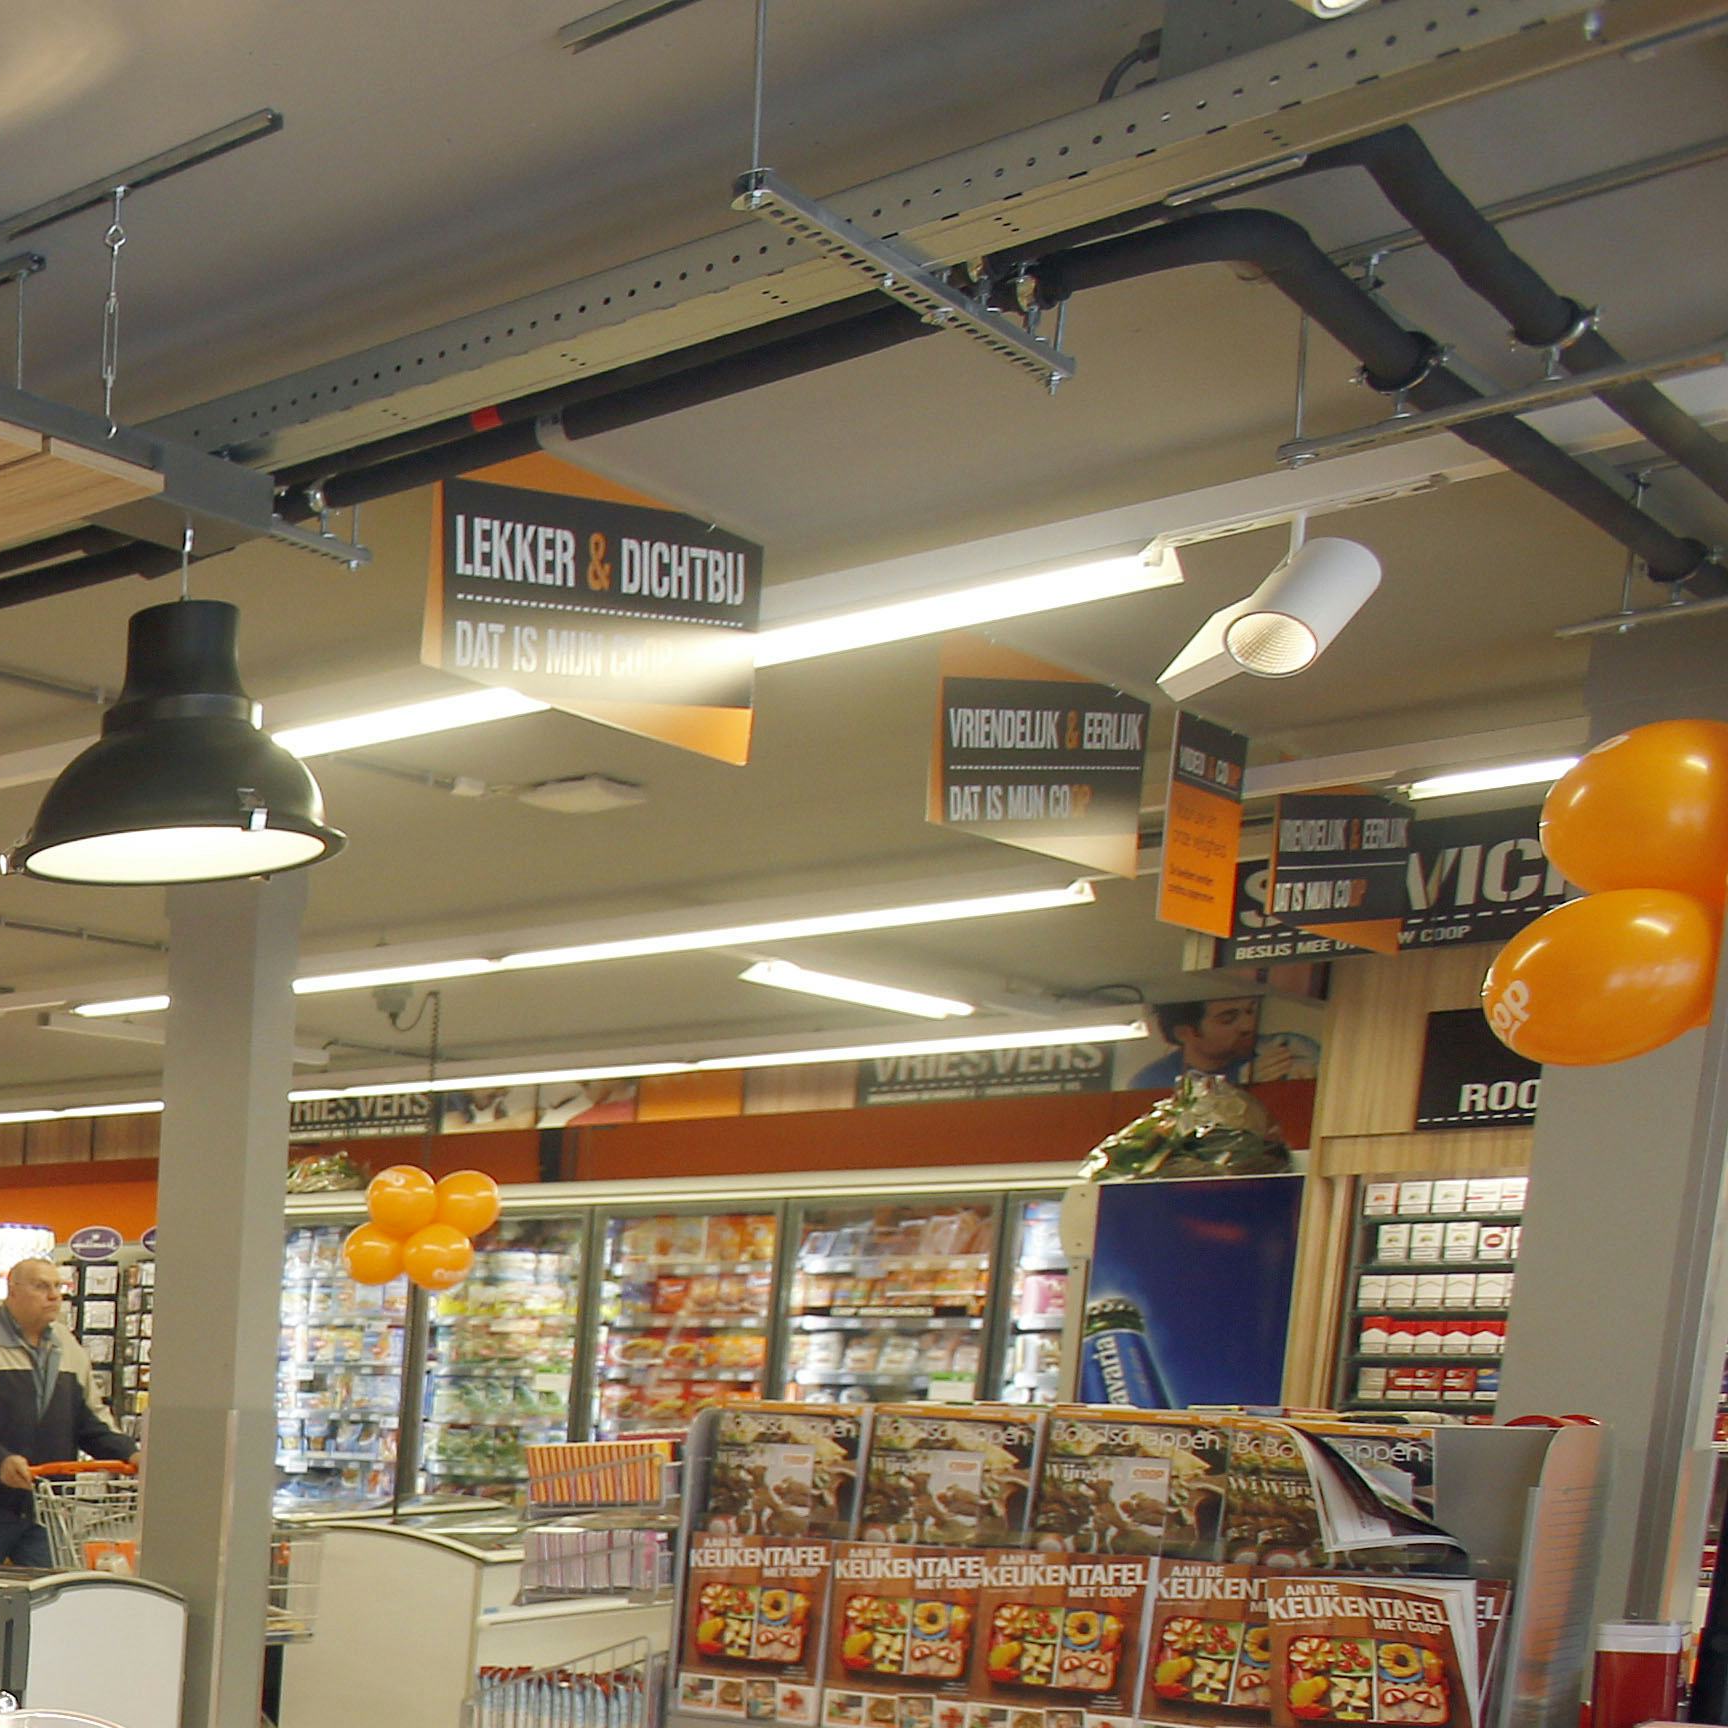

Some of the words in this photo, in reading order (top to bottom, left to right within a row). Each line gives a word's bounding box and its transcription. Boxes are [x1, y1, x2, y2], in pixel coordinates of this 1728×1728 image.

[455, 514, 576, 589] LEKKER
[587, 532, 612, 591] &
[621, 537, 745, 606] DICHTBIJ
[455, 619, 505, 669] DAT
[512, 625, 538, 673] IS
[546, 628, 603, 676] MIJN
[949, 707, 1061, 750] VRIENDELIJK
[1065, 710, 1080, 750] &
[1083, 711, 1144, 751] EERLIJK
[950, 784, 982, 822] DAT
[986, 785, 1004, 821] IS
[1008, 784, 1044, 821] MIJN
[1049, 784, 1092, 821] COOP
[1420, 925, 1472, 944] COOP
[1296, 938, 1331, 955] MEE
[292, 1094, 432, 1123] RIESVERS
[1091, 1336, 1129, 1404] avaria
[703, 1537, 728, 1548] AAN
[730, 1537, 744, 1548] DE
[690, 1547, 831, 1569] KEUKENTAFEL
[835, 1557, 984, 1580] KEUKENTAFE
[999, 1554, 1026, 1565] AAN
[1029, 1554, 1045, 1565] DE
[762, 1567, 788, 1578] MET
[982, 1564, 1148, 1588] KEUKENTAFEL
[1068, 1586, 1096, 1598] MET
[1100, 1586, 1137, 1598] COOP
[1155, 1577, 1268, 1600] KEUKENT
[1285, 1584, 1316, 1597] AAN
[1320, 1585, 1340, 1596] DE
[1267, 1597, 1451, 1625] KEUKENTAFEL
[1374, 1618, 1405, 1631] MET
[1408, 1621, 1444, 1635] COOP
